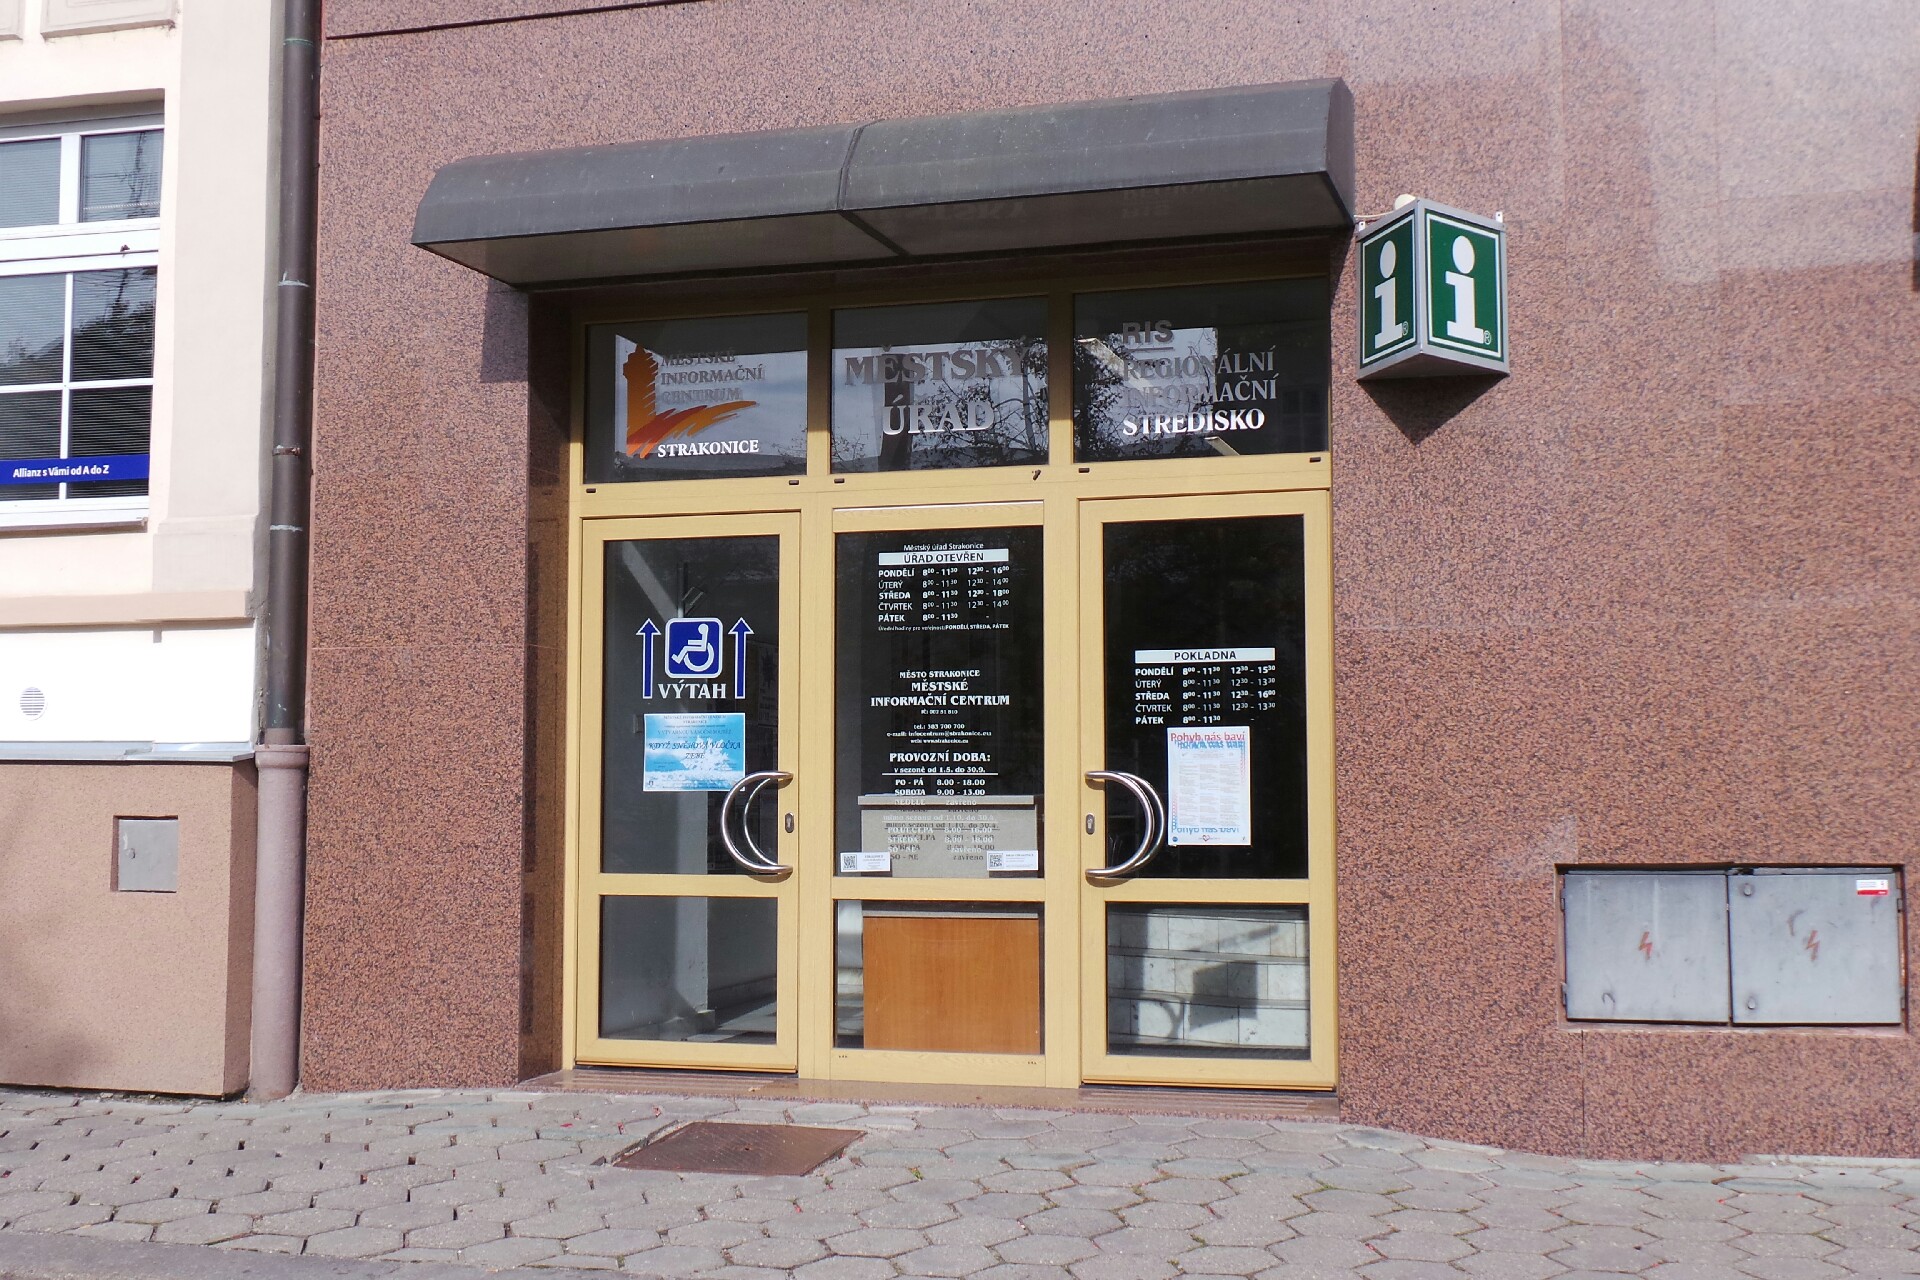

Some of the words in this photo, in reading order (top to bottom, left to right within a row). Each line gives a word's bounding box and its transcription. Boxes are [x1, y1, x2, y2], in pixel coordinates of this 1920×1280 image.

[1122, 320, 1174, 345] RIS
[1123, 345, 1276, 382] REGIONÁLNÍ
[660, 363, 765, 385] INFORMAČNÍ
[662, 387, 744, 404] CENTRUM
[1124, 373, 1279, 408] INFORMAČNÍ
[657, 440, 760, 457] STRAKONICE
[13, 467, 41, 478] Allianz
[48, 466, 69, 476] Vámi
[70, 466, 82, 475] od
[83, 465, 90, 475] A
[90, 465, 101, 475] do
[102, 465, 110, 474] Z
[948, 542, 984, 550] Strakonice
[904, 553, 933, 564] ÚŘAD
[936, 552, 984, 563] OTEVŘEN
[878, 567, 915, 578] PONDĚLÍ
[878, 579, 904, 589] ÚTERÝ
[878, 590, 911, 600] STŘEDA
[878, 601, 913, 611] ČTVRTEK
[878, 613, 905, 623] PÁTEK
[1174, 650, 1237, 661] POKLADNA
[899, 669, 927, 679] MĚSTO
[928, 669, 981, 678] STRAKONICE
[1135, 666, 1174, 677] PONDĚLÍ
[658, 679, 727, 699] VÝTAH
[911, 678, 969, 692] MĚSTSKÉ
[1135, 678, 1162, 689] ÚTERÝ
[870, 693, 947, 707] INFORMAČNÍ
[950, 694, 1010, 706] CENTRUM
[1135, 691, 1170, 701] STŘEDA
[1135, 703, 1172, 713] ČTVRTEK
[1135, 715, 1164, 725] PÁTEK
[1170, 732, 1201, 742] Pohyb
[1204, 731, 1222, 741] nás
[889, 749, 950, 763] PROVOZNÍ
[953, 752, 991, 762] DOBA:
[913, 777, 924, 786] PÁ
[894, 788, 926, 796] SOBOTA
